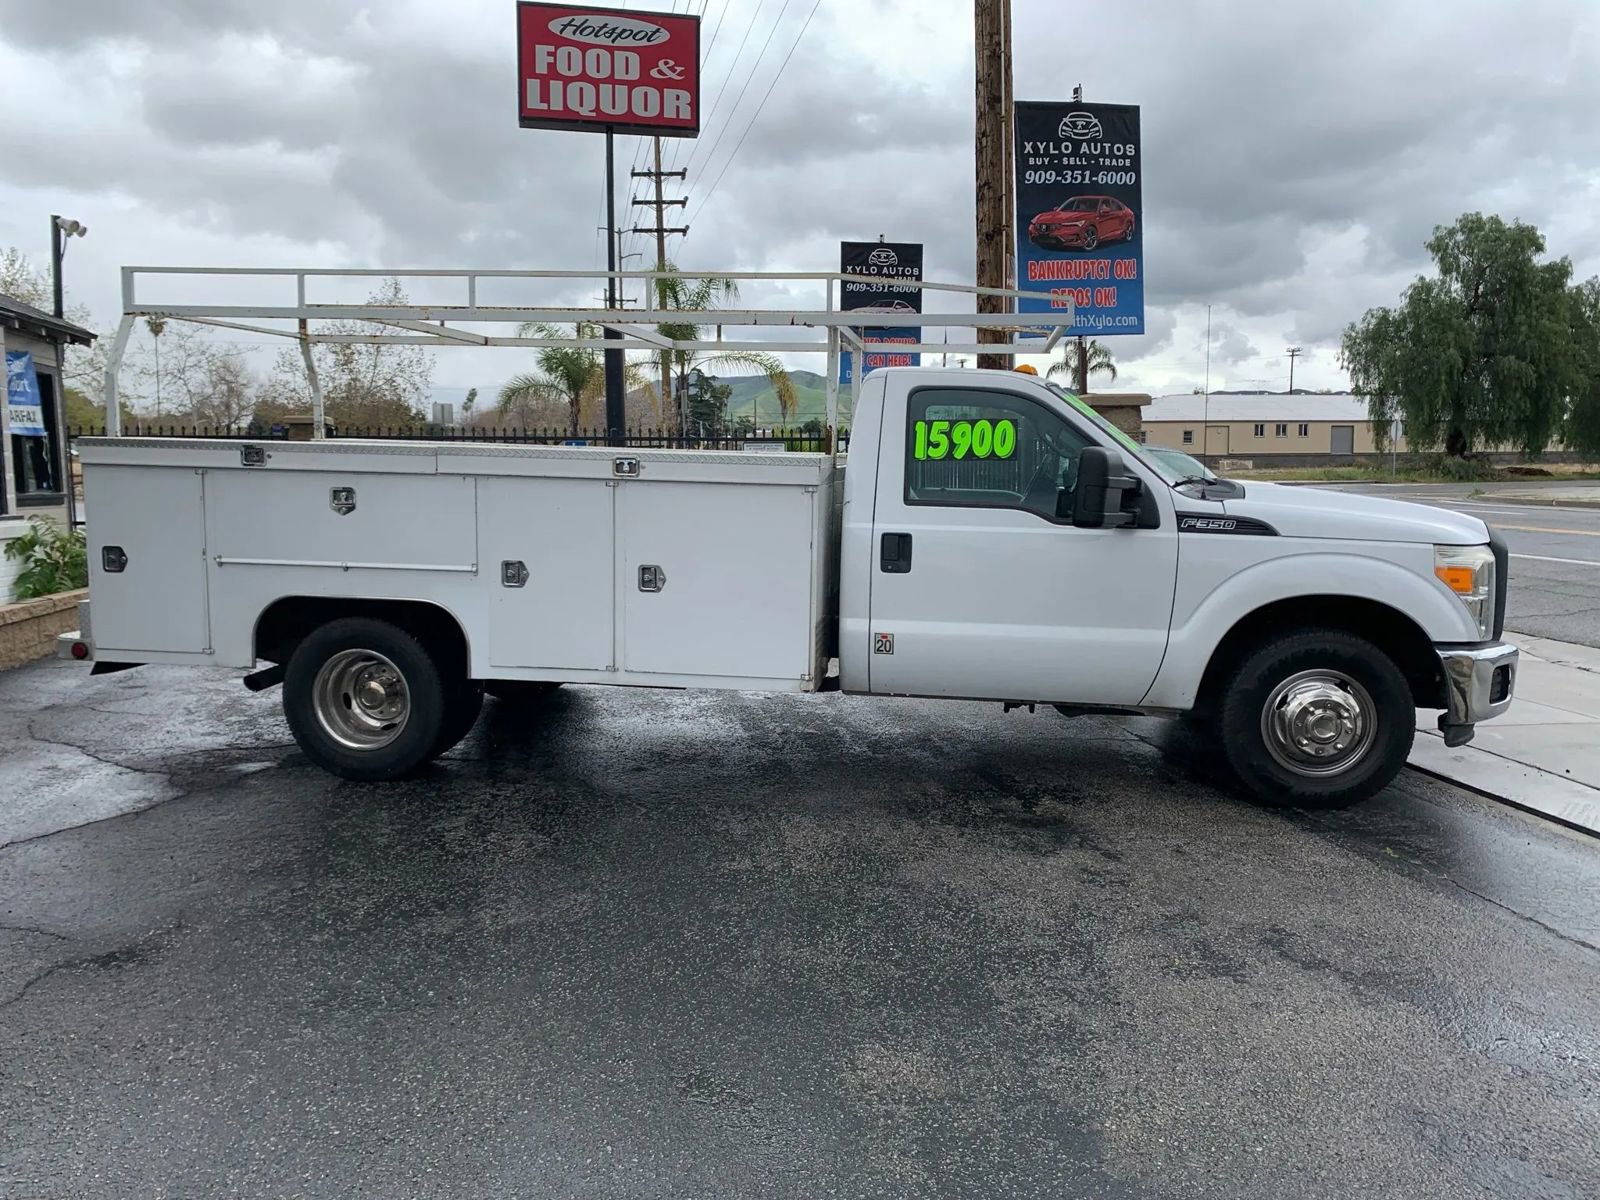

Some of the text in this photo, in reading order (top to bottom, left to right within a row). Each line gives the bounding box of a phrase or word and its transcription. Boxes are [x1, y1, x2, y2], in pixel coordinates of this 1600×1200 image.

[560, 18, 662, 44] Hotspot
[535, 44, 685, 81] FOOD &
[526, 78, 692, 120] LIQUOR
[1023, 141, 1136, 156] XYLO AUTOS
[1028, 157, 1050, 165] BUY
[1062, 157, 1088, 165] SELL
[1099, 158, 1131, 167] TRADE
[1024, 170, 1137, 185] 909-351-6000
[846, 265, 920, 276] XYLO AUTOS
[1028, 258, 1137, 281] BANKRUPTCY OK!
[846, 283, 919, 293] 909-351-6000
[1093, 286, 1118, 308] OK!
[867, 354, 885, 367] CAN
[887, 354, 912, 367] HELP!
[9, 409, 37, 422] ARFAX
[914, 419, 1017, 461] 15900
[876, 639, 892, 653] 20
